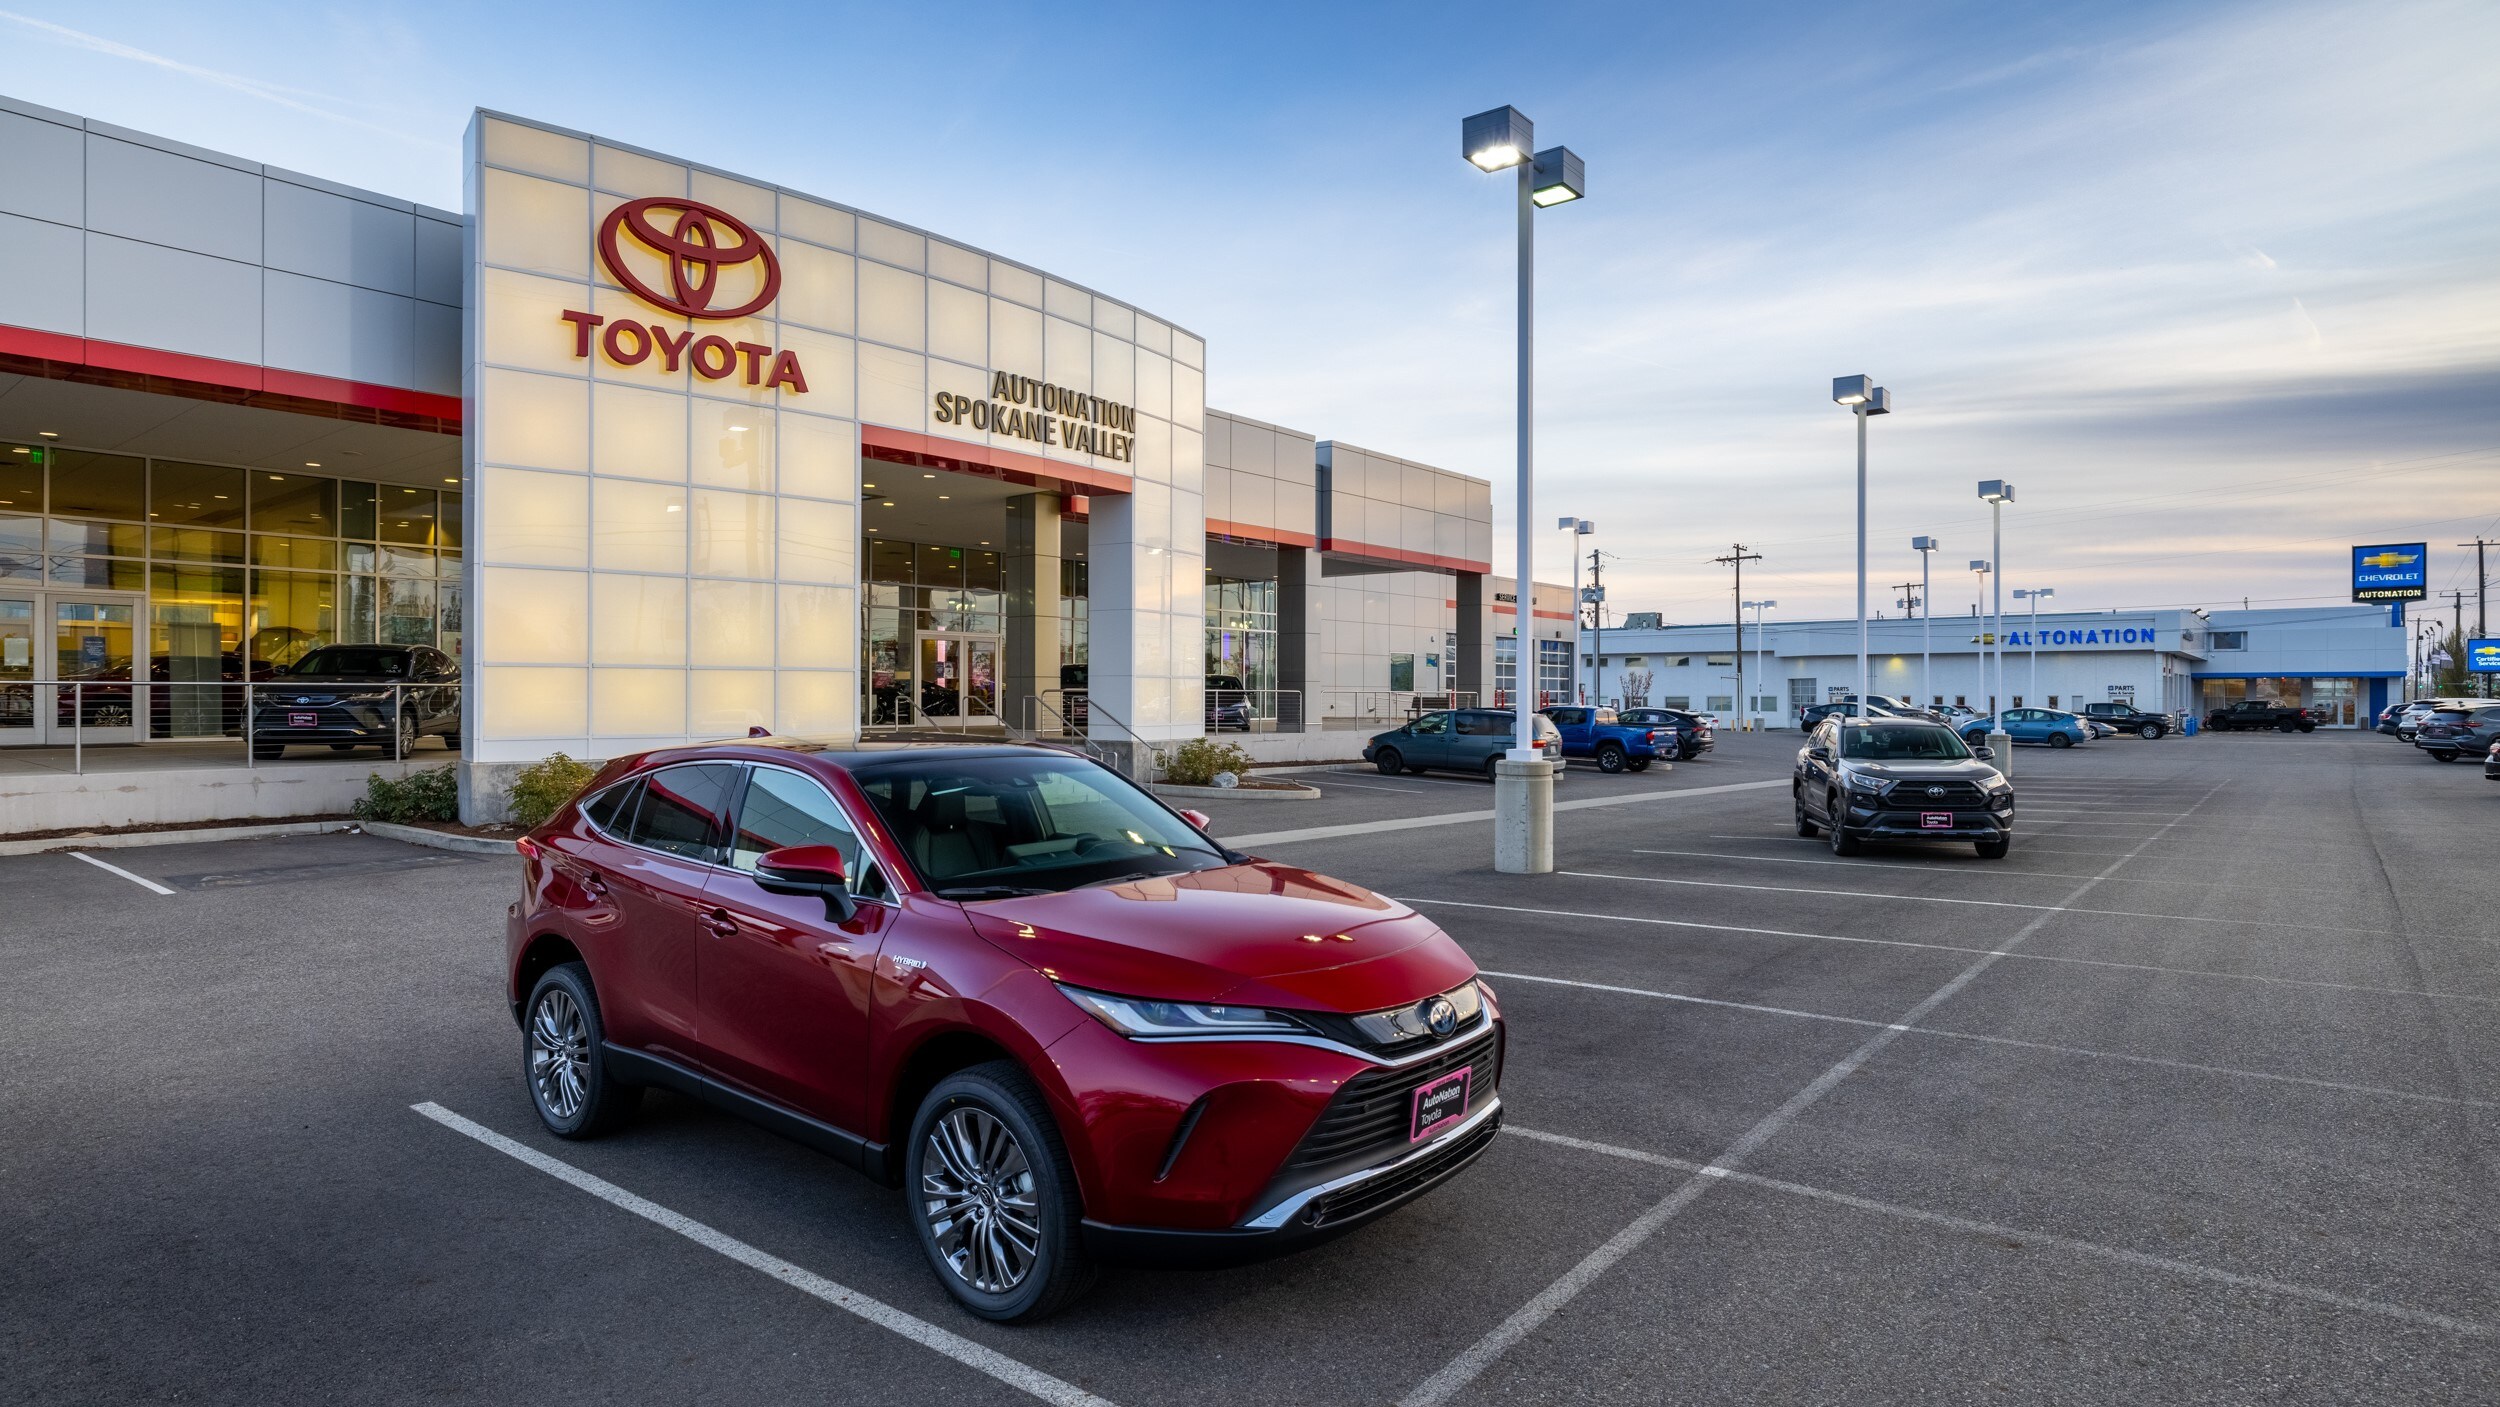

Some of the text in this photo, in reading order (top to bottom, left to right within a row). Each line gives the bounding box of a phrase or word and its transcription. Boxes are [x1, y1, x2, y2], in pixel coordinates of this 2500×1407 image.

[561, 309, 809, 393] TOYOTA
[992, 370, 1135, 433] AUTONATION
[935, 391, 1135, 462] SPOKANE VALLEY
[2358, 573, 2419, 581] CHEVROLET
[2358, 590, 2421, 598] AUTONATION
[893, 955, 921, 968] HYBRID
[1423, 1085, 1460, 1110] AutoNation
[1421, 1108, 1442, 1126] Toyota
